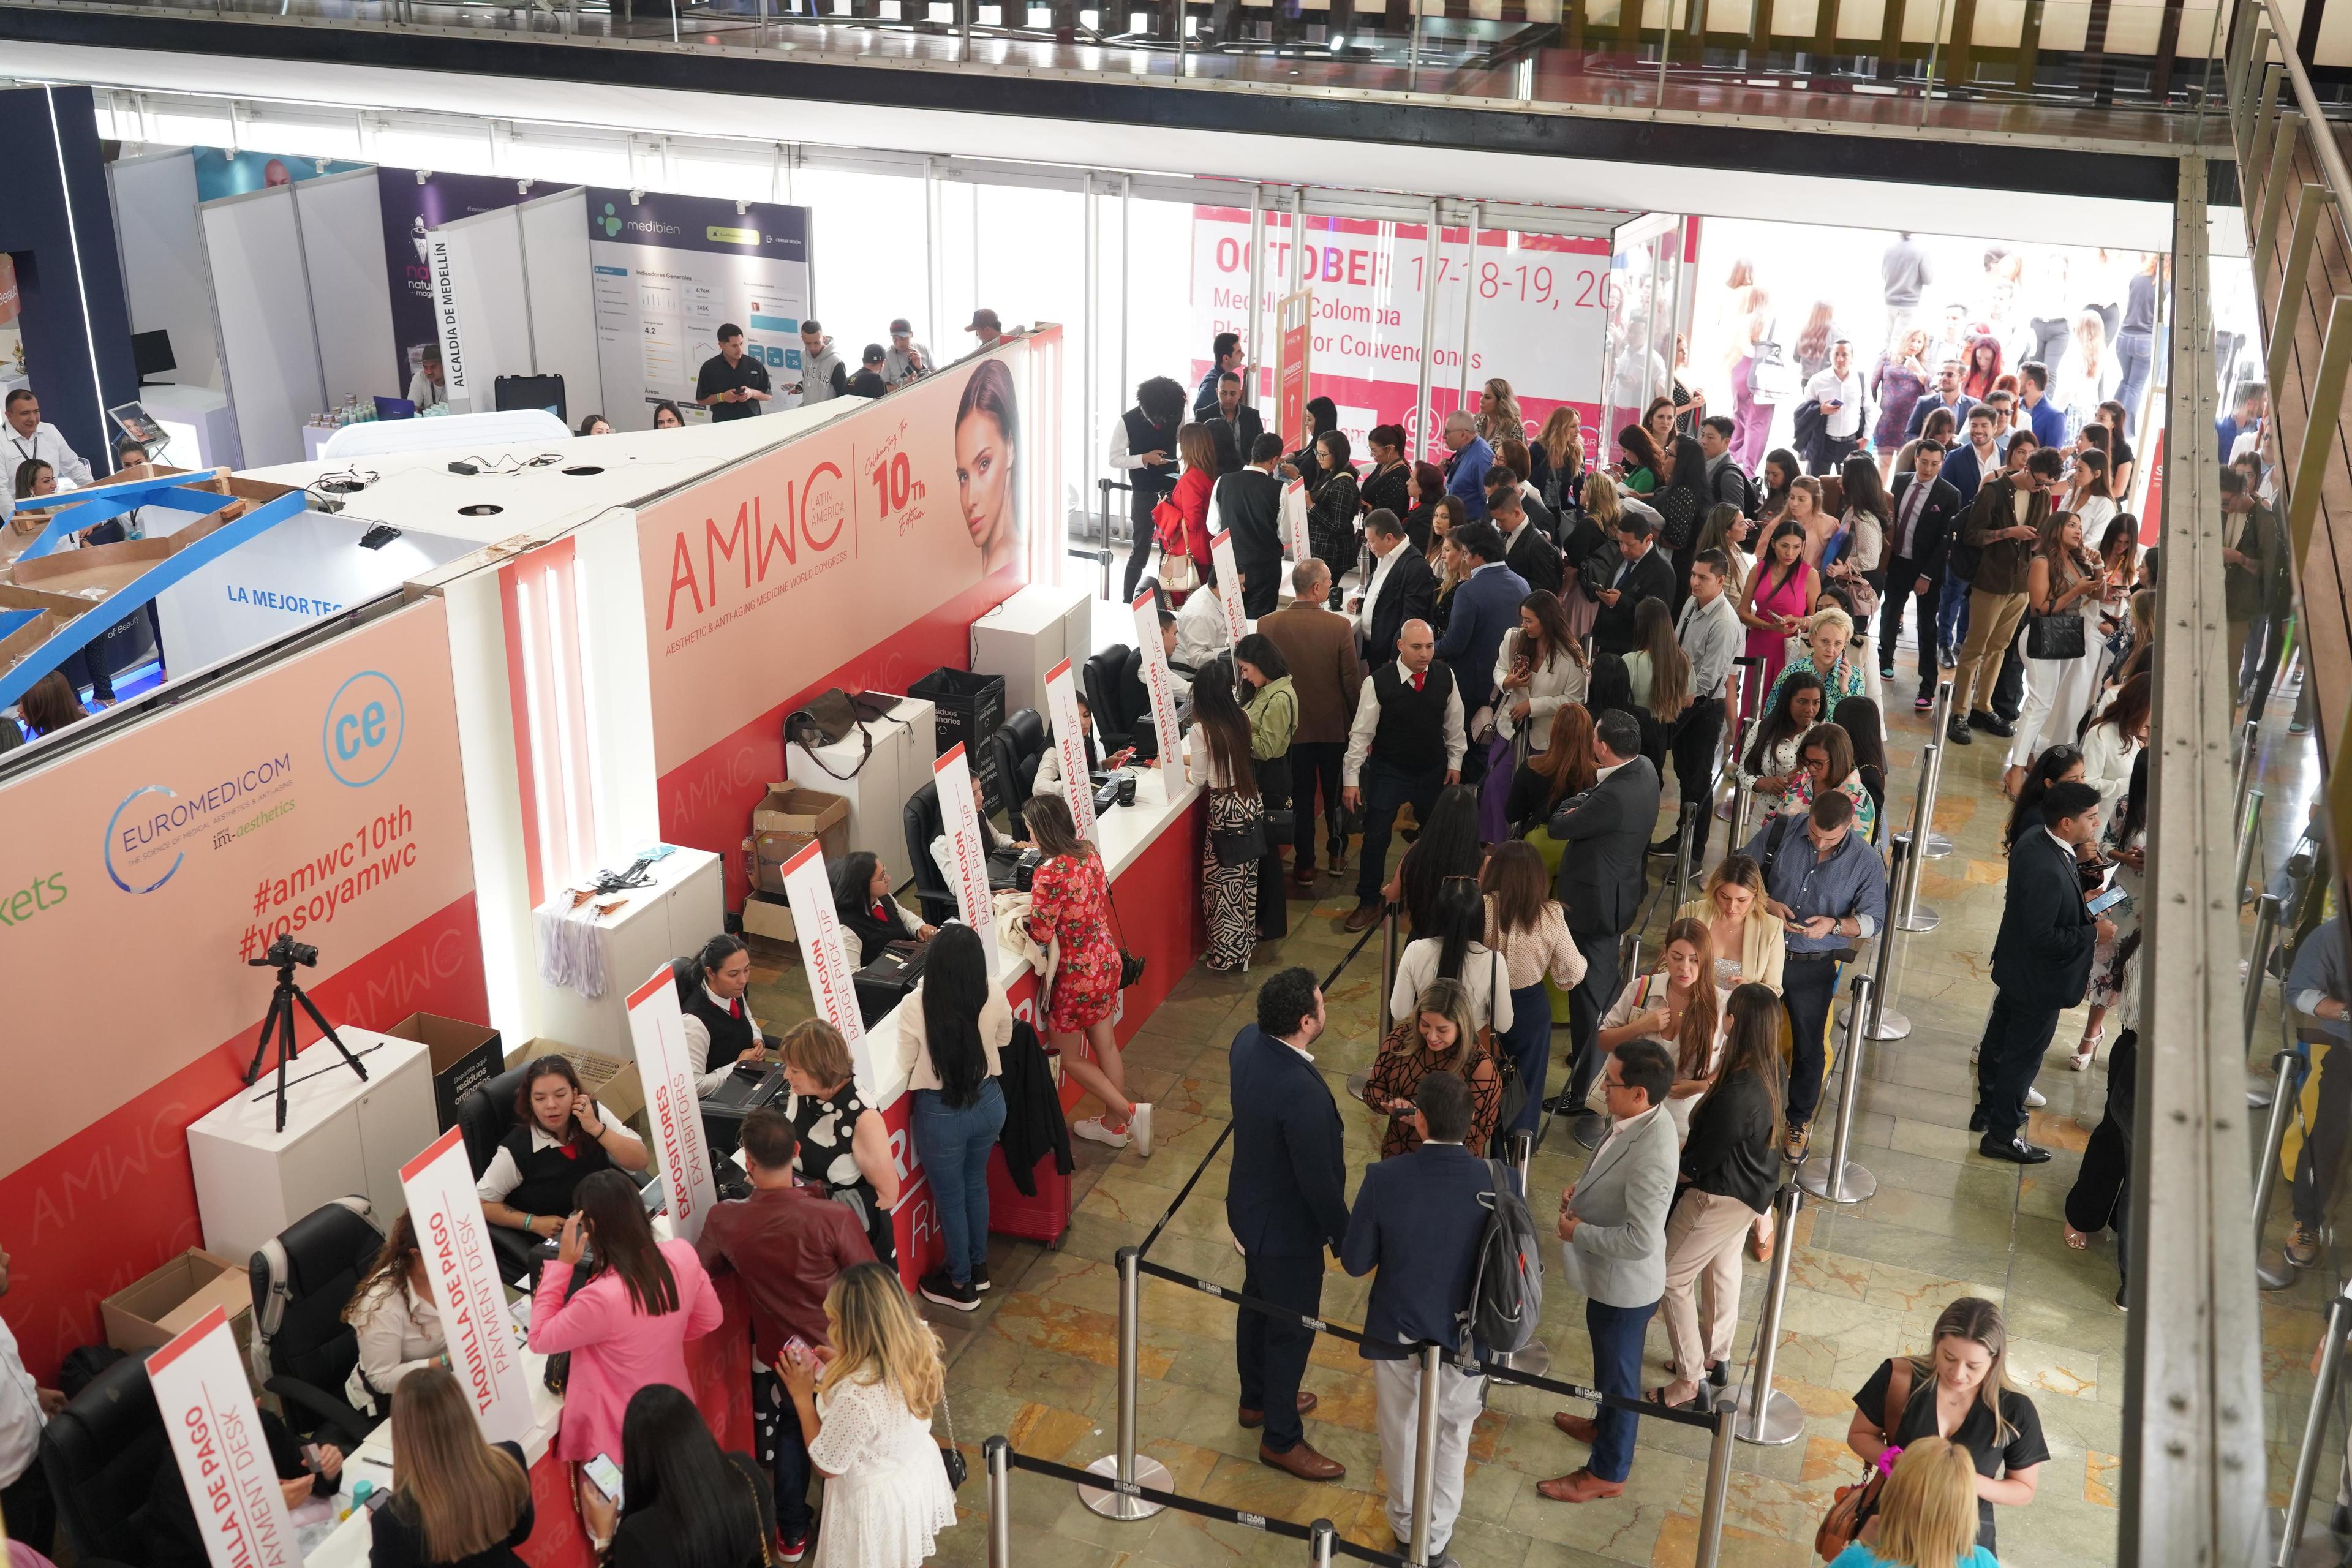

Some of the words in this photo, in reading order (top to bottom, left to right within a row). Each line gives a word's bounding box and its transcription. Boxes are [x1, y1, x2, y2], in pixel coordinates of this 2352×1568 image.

[627, 220, 680, 235] medibien
[434, 243, 453, 305] MEDELLÍN
[444, 307, 456, 325] DE
[445, 327, 464, 387] ALCALDÍA
[810, 489, 832, 511] LATIN
[811, 500, 845, 527] AMERICA
[899, 505, 925, 537] Edition
[666, 461, 844, 631] AMWC
[108, 628, 116, 639] of
[118, 614, 140, 634] Beauty
[227, 585, 249, 604] LA
[252, 589, 310, 614] MEJOR
[666, 625, 707, 657] AESTHETIC
[709, 622, 714, 633] &
[715, 600, 755, 630] ANTI-AGING
[756, 581, 789, 607] MEDICINE
[790, 568, 813, 589] WORLD
[814, 550, 848, 576] CONGRESS
[1230, 578, 1245, 629] PICK-UP
[1155, 641, 1170, 696] PICK-UP
[335, 701, 386, 761] ce
[1150, 662, 1172, 764] ACREDITACIÓN
[1165, 699, 1178, 745] BADGE
[1069, 715, 1084, 774] PICK-UP
[123, 753, 291, 852] EUROMEDICOM
[128, 855, 141, 867] THE
[142, 842, 170, 860] SCIENCE
[172, 835, 181, 846] OF
[183, 822, 211, 840] MEDICAL
[213, 801, 251, 824] AESTHETICS
[258, 779, 293, 802] ANTI-AGING
[213, 799, 295, 850] im-aesthetics
[1079, 777, 1092, 827] BADGE
[253, 804, 412, 917] #amwc10th
[963, 804, 981, 869] PICK-UP
[239, 842, 417, 963] #yosoyamwc
[976, 871, 990, 925] BADGE
[820, 910, 844, 980] PICK-UP
[838, 981, 859, 1040] BADGE
[454, 1064, 476, 1084] Deposita
[476, 1054, 488, 1069] aquí
[456, 1066, 487, 1093] residuos
[656, 1085, 690, 1221] EXPOSITORES
[673, 1073, 704, 1186] EXHIBITORS
[429, 1212, 456, 1276] PAGO
[456, 1213, 484, 1272] DESK
[446, 1273, 466, 1308] DE
[473, 1277, 510, 1375] PAYMENT
[457, 1306, 492, 1416] TAQUILLA
[185, 1405, 219, 1478] PAGO
[220, 1404, 255, 1471] DESK
[207, 1474, 232, 1515] DE
